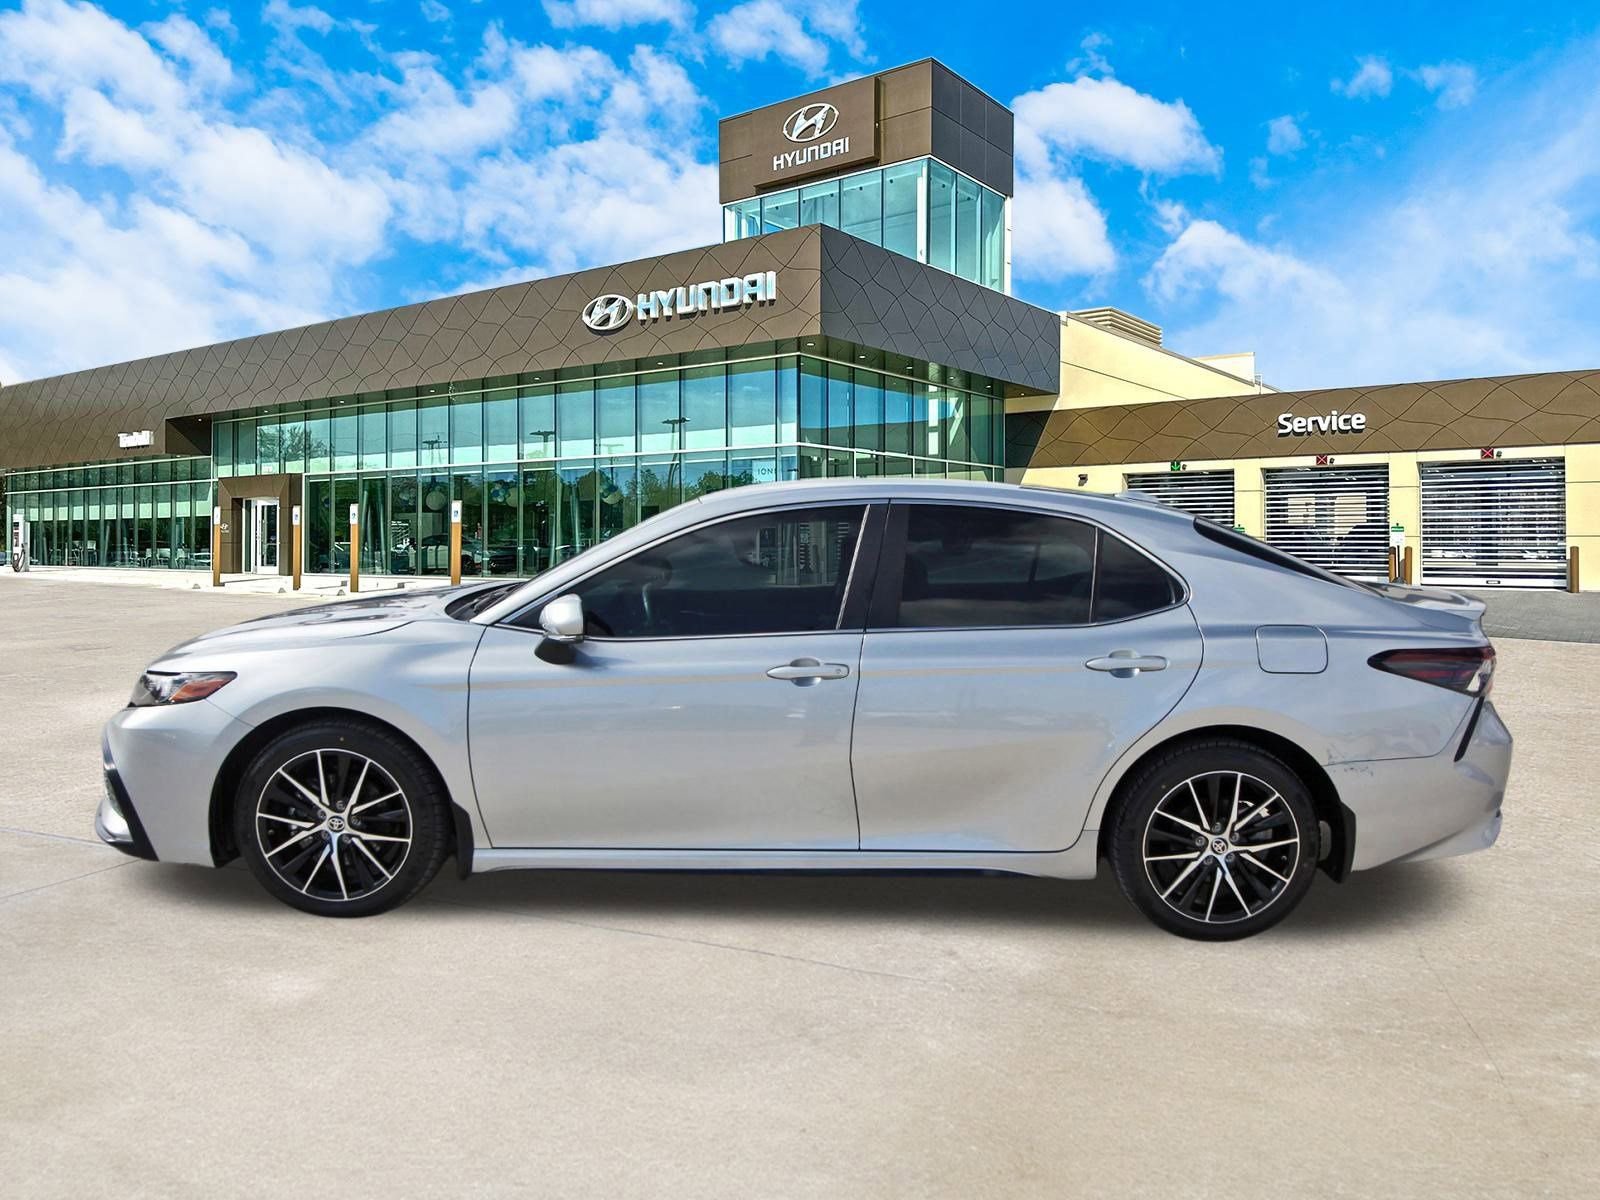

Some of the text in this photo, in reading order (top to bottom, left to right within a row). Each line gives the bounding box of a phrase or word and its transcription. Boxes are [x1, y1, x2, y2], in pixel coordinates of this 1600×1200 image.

[773, 137, 849, 170] HYUNDAI
[637, 271, 777, 320] HYUNDAI
[1278, 410, 1366, 434] Service
